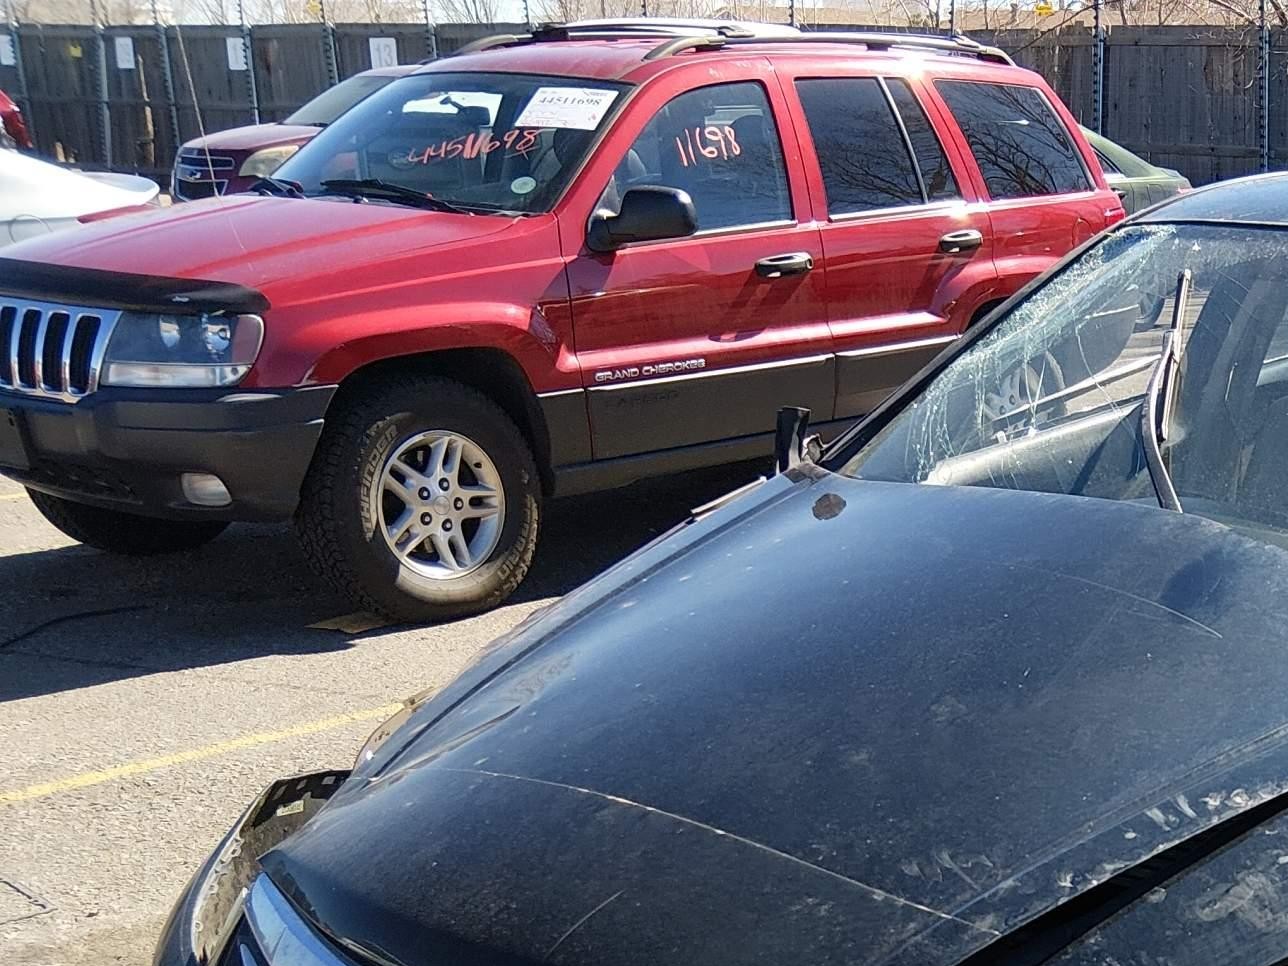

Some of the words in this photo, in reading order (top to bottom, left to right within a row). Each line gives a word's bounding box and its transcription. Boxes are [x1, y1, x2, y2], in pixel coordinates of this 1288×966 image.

[373, 43, 393, 67] 13
[676, 126, 741, 168] 11698
[595, 367, 640, 382] GRAND
[641, 358, 706, 376] CHEROKEE
